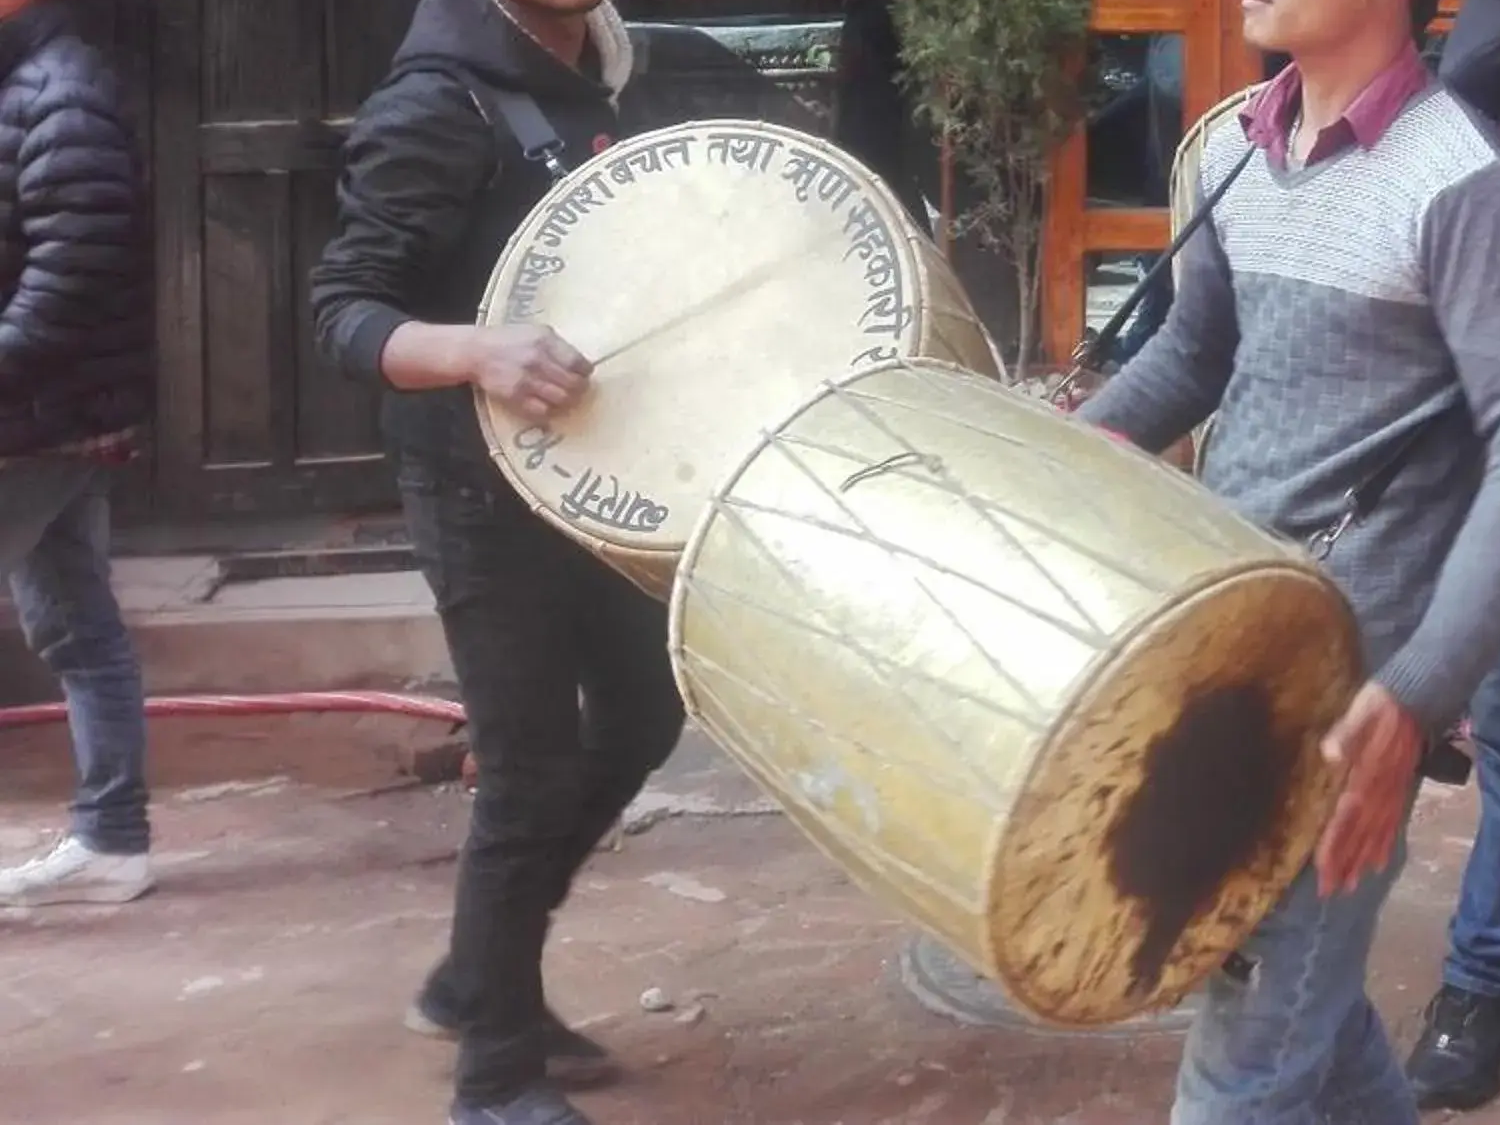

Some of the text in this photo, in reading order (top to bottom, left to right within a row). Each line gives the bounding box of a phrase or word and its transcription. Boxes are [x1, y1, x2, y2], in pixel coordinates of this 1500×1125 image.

[604, 136, 698, 185] बचत
[707, 132, 784, 172] तथा
[842, 196, 914, 341] सहकारी
